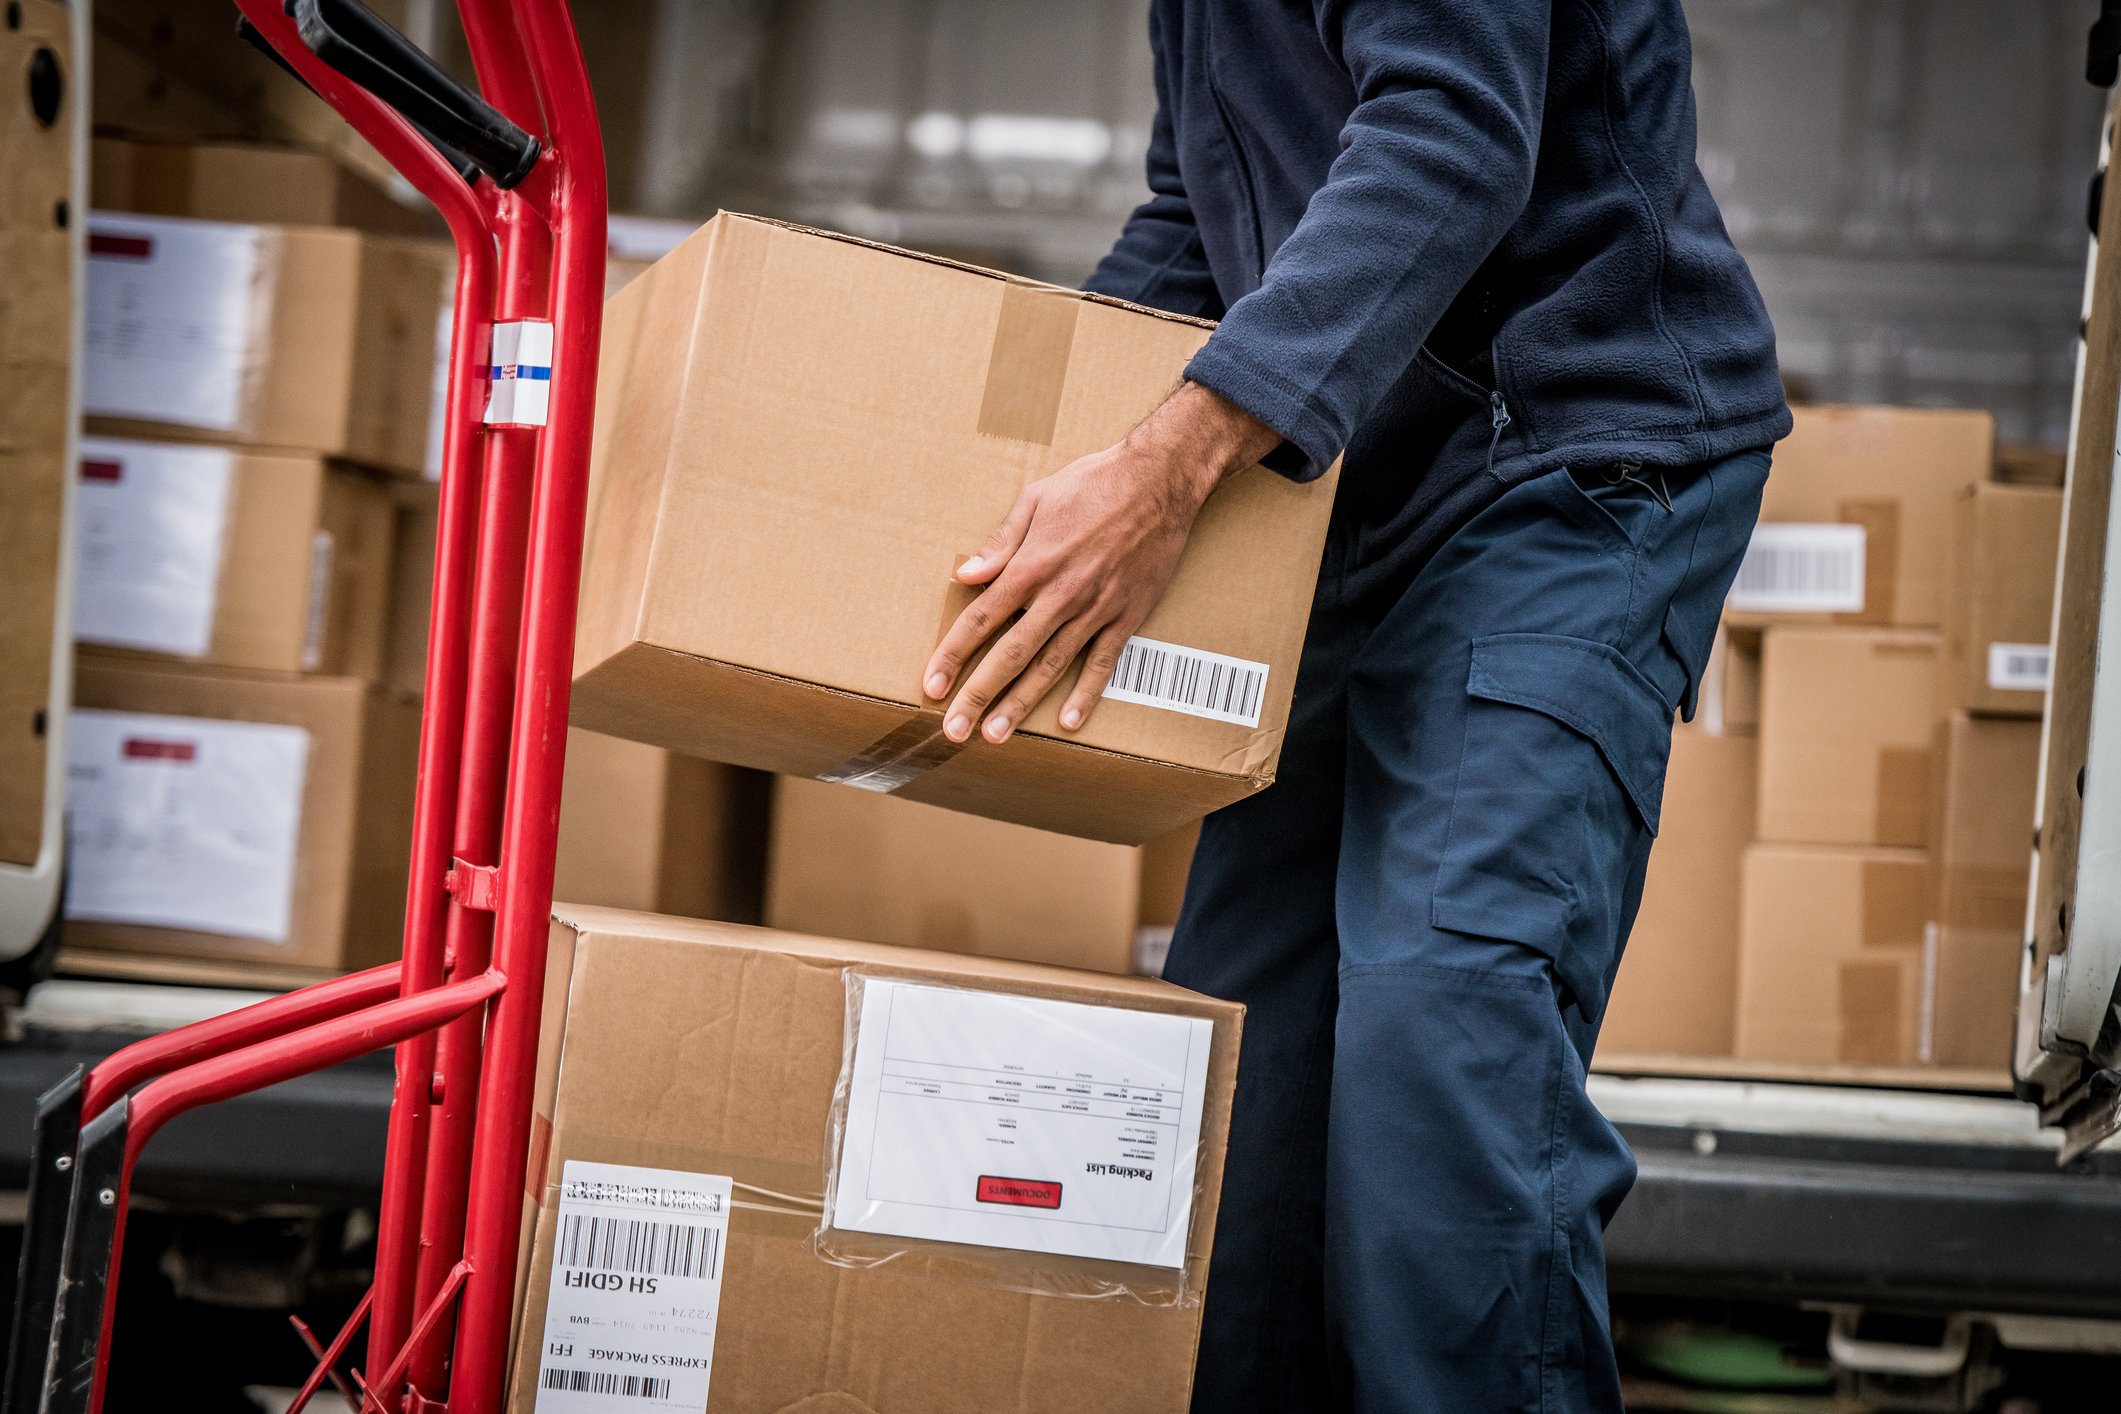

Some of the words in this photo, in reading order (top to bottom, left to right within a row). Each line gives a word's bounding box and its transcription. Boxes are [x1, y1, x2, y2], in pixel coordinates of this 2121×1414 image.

[1086, 1163, 1107, 1176] List
[1108, 1164, 1153, 1181] Packing
[988, 1185, 1050, 1200] DOCUMENTS
[564, 1270, 624, 1291] GDIFI
[629, 1276, 658, 1294] 5H
[570, 1315, 590, 1325] BVB
[672, 1306, 712, 1320] 72274
[550, 1342, 573, 1357] FFI
[589, 1348, 649, 1364] PACKAGE
[652, 1354, 708, 1369] EXPRESS
